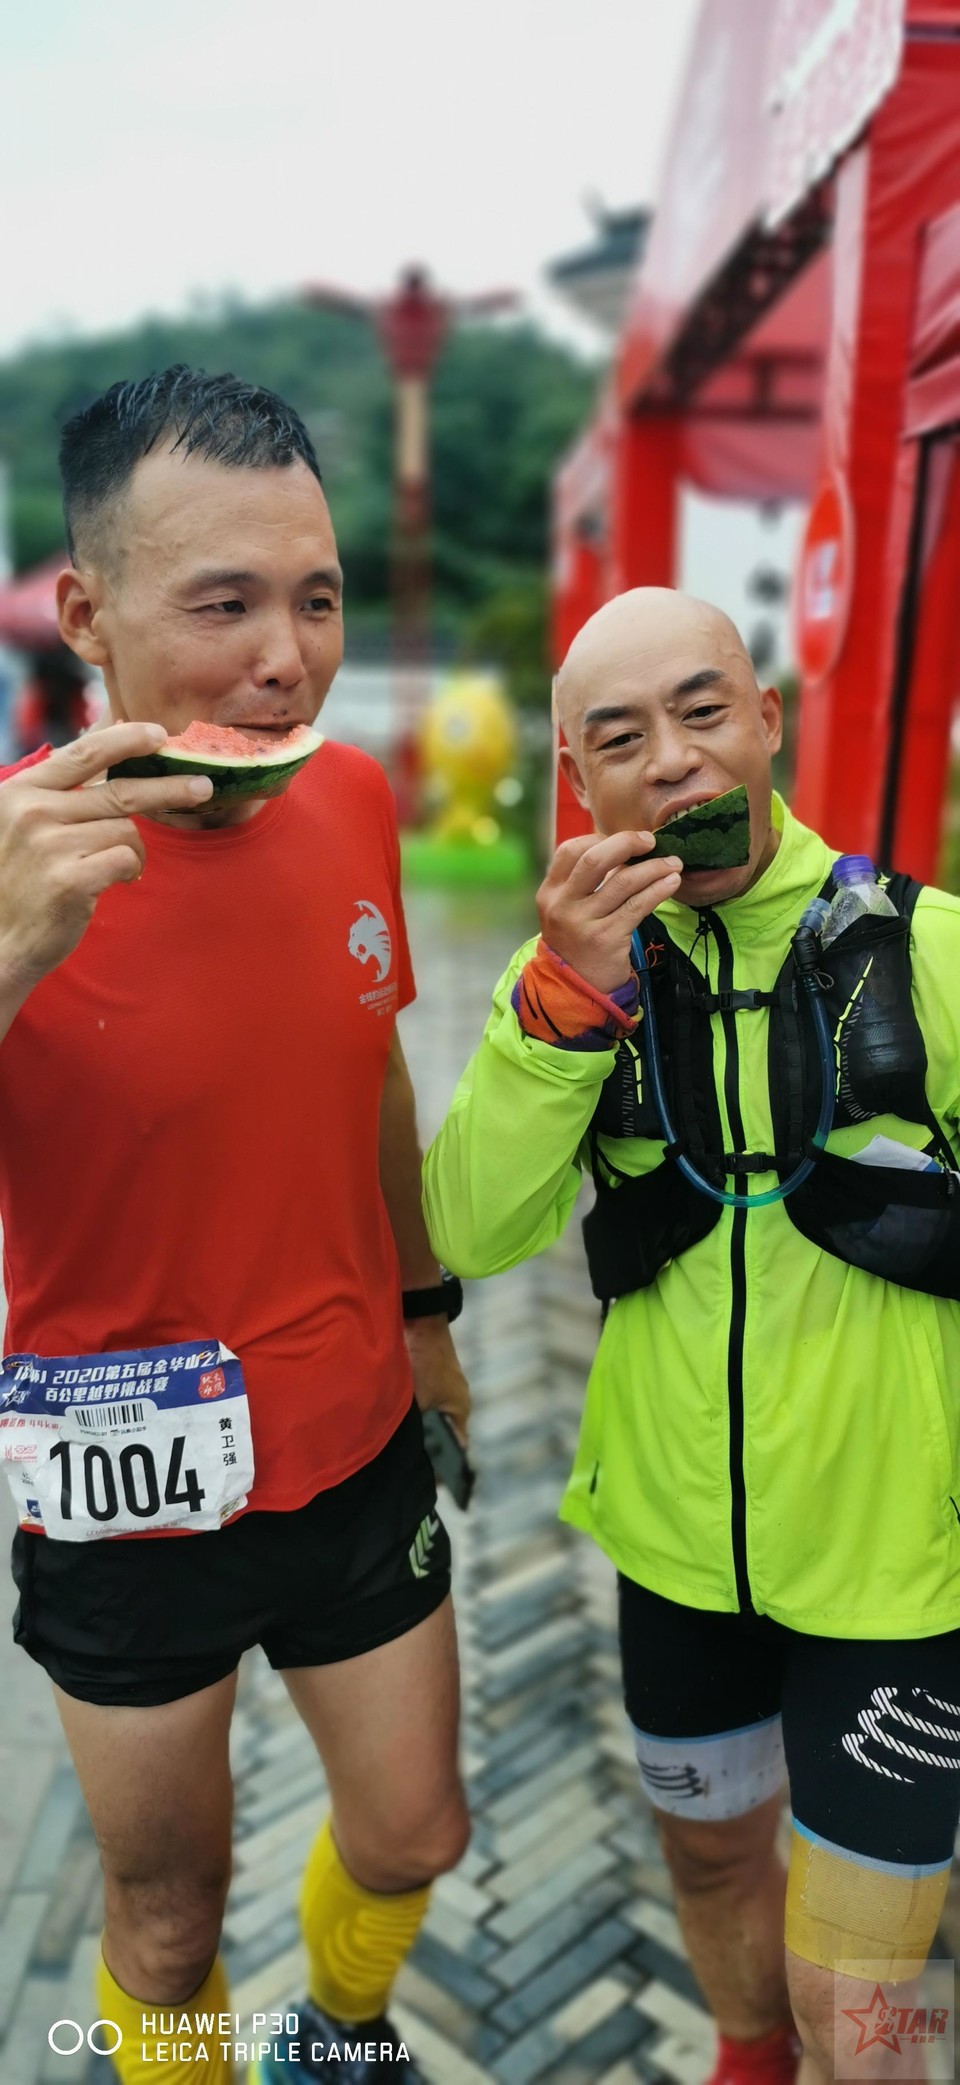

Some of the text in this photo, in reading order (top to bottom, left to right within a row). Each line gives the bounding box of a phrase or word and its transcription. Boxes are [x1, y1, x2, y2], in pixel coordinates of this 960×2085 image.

[53, 1352, 220, 1385] 2020第五届金华山之
[45, 1376, 169, 1403] 百公里越野挑战赛
[219, 1417, 238, 1466] 黄卫强
[50, 1435, 205, 1522] 1004
